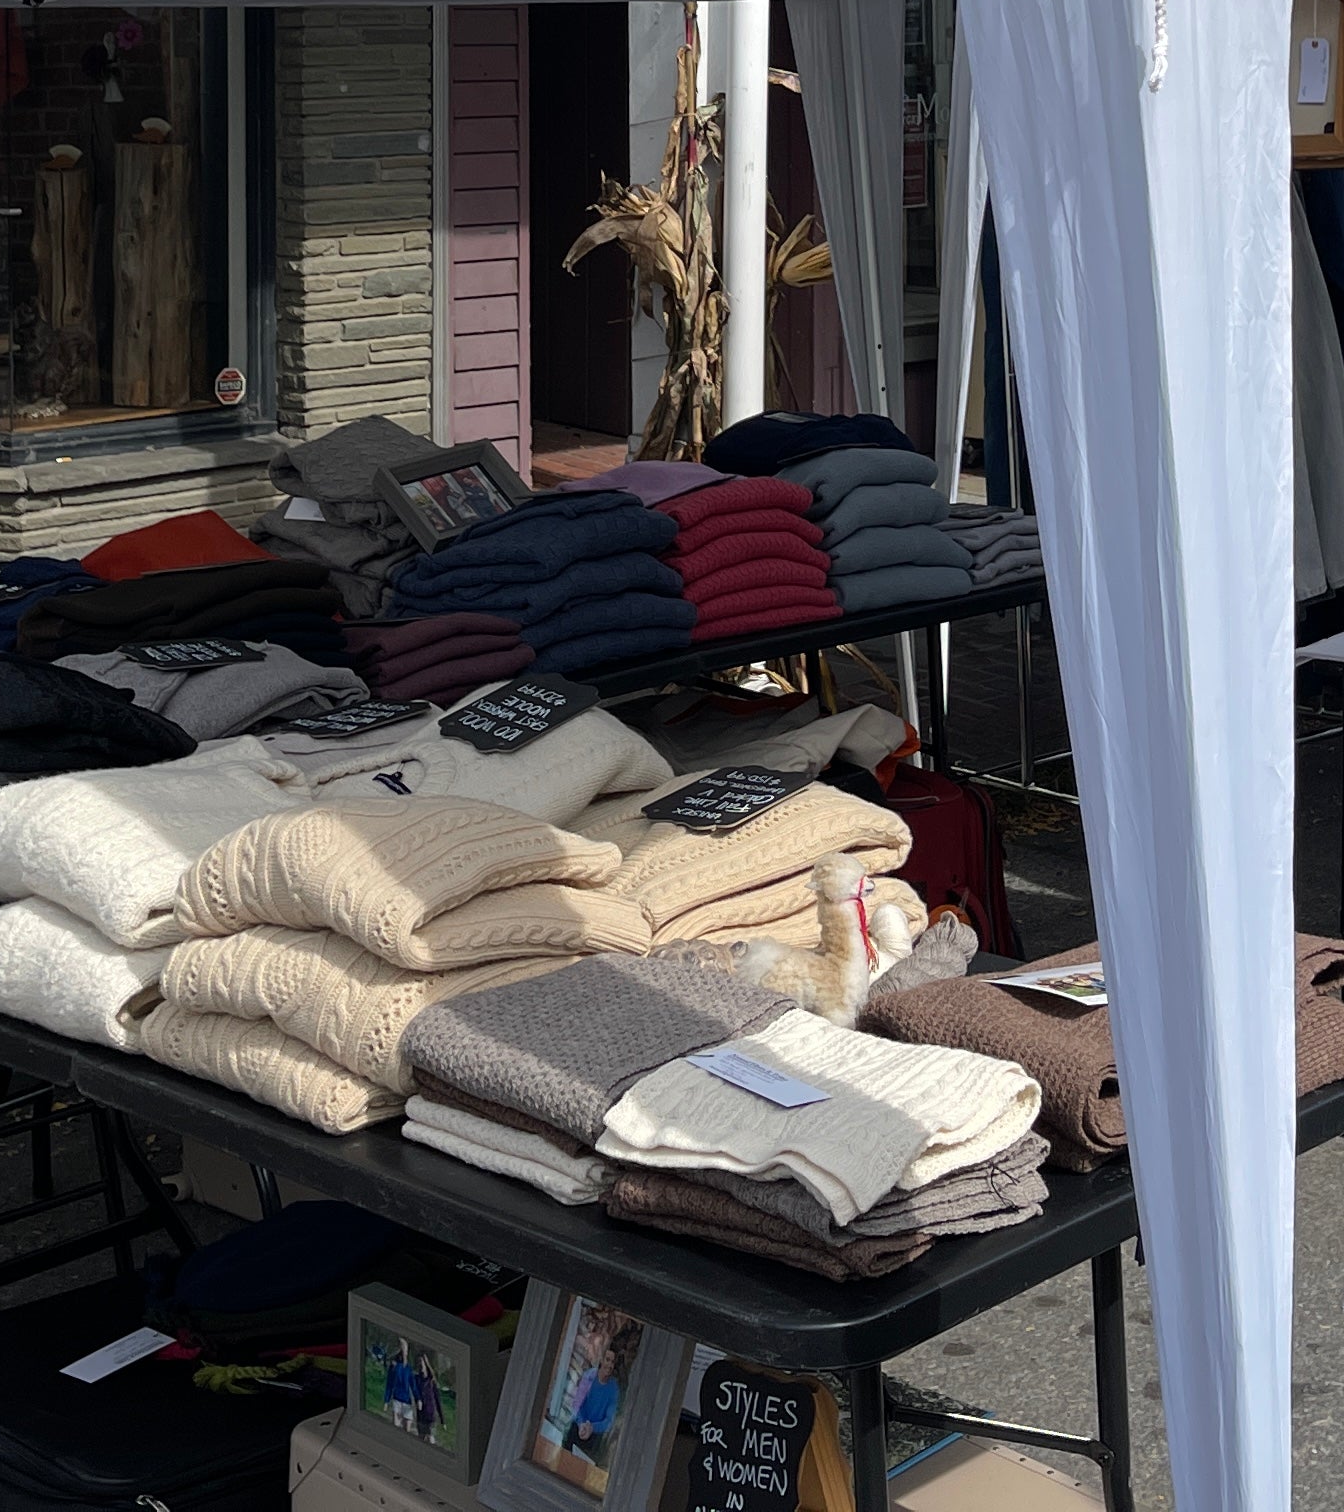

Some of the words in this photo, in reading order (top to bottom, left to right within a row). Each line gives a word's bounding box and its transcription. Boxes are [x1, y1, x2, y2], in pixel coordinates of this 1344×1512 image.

[458, 710, 498, 733] WOOL
[715, 1381, 799, 1430] STYLES
[700, 1420, 728, 1449] FOR
[741, 1428, 788, 1465] MEN
[717, 1455, 789, 1497] WOMEN
[725, 1490, 745, 1511] IN
